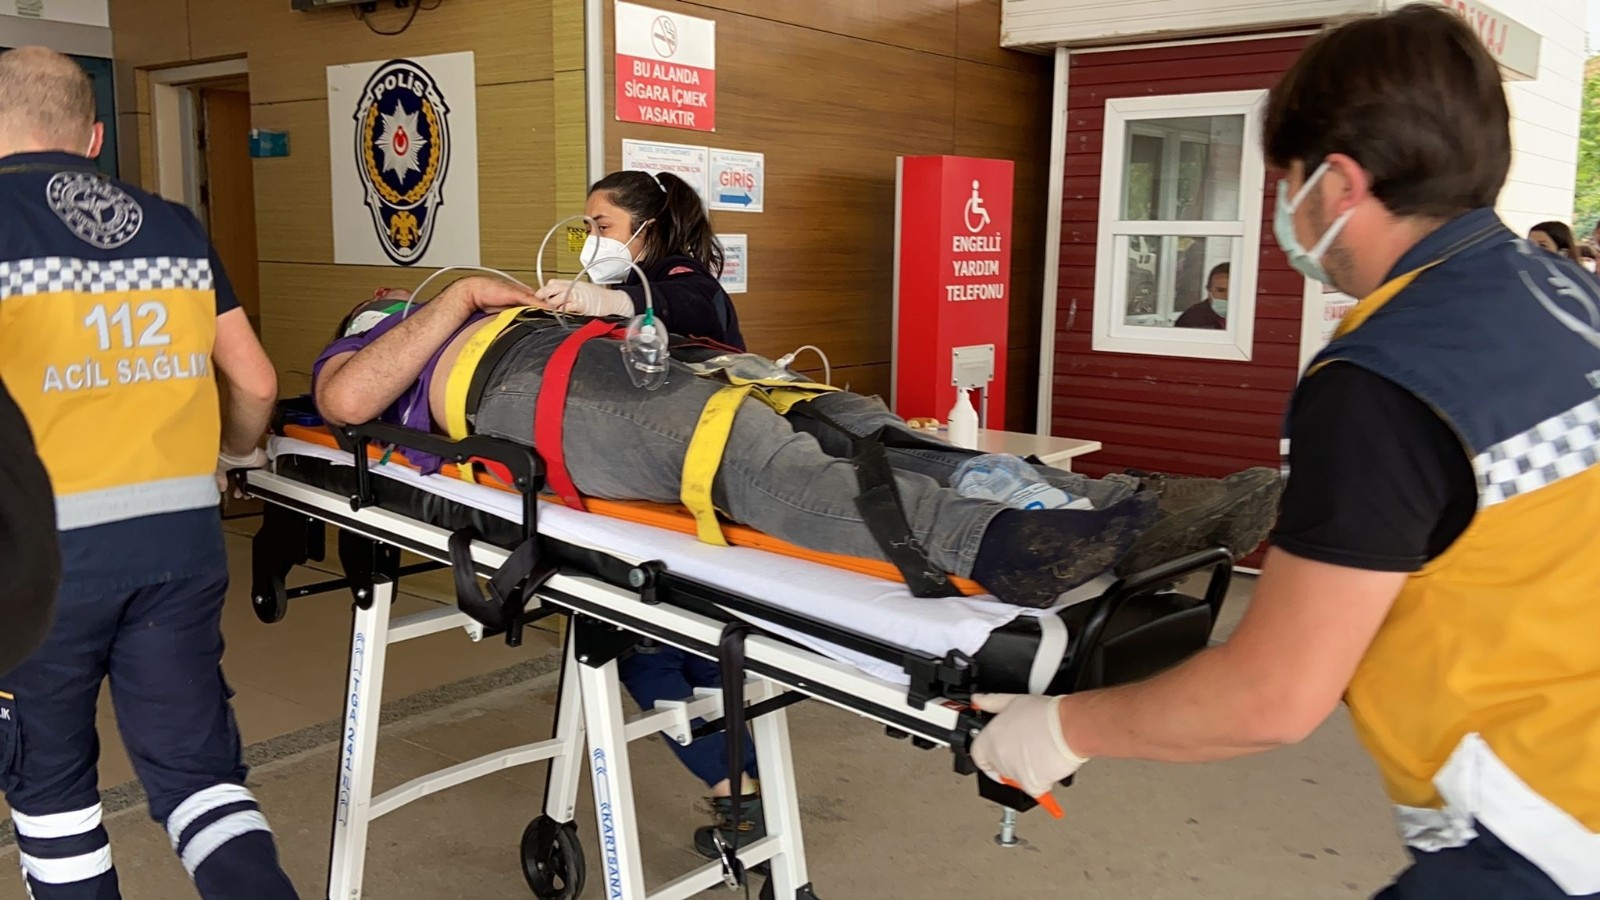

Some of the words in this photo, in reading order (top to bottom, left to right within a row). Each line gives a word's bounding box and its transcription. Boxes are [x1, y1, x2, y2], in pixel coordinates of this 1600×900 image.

[633, 60, 651, 77] BU
[653, 64, 700, 85] ALANDA
[374, 72, 424, 101] POLİS
[625, 79, 671, 103] SİGARA
[672, 86, 707, 107] İÇMEK
[638, 105, 695, 126] YASAKTIR
[720, 168, 754, 192] GİRİŞ
[952, 232, 1001, 252] ENGELLİ
[952, 260, 999, 277] YARDIM
[945, 283, 1004, 302] TELEFONU
[85, 300, 171, 350] 112
[43, 357, 110, 392] ACİL
[345, 727, 355, 771] 241
[601, 811, 622, 898] KARTSANA
